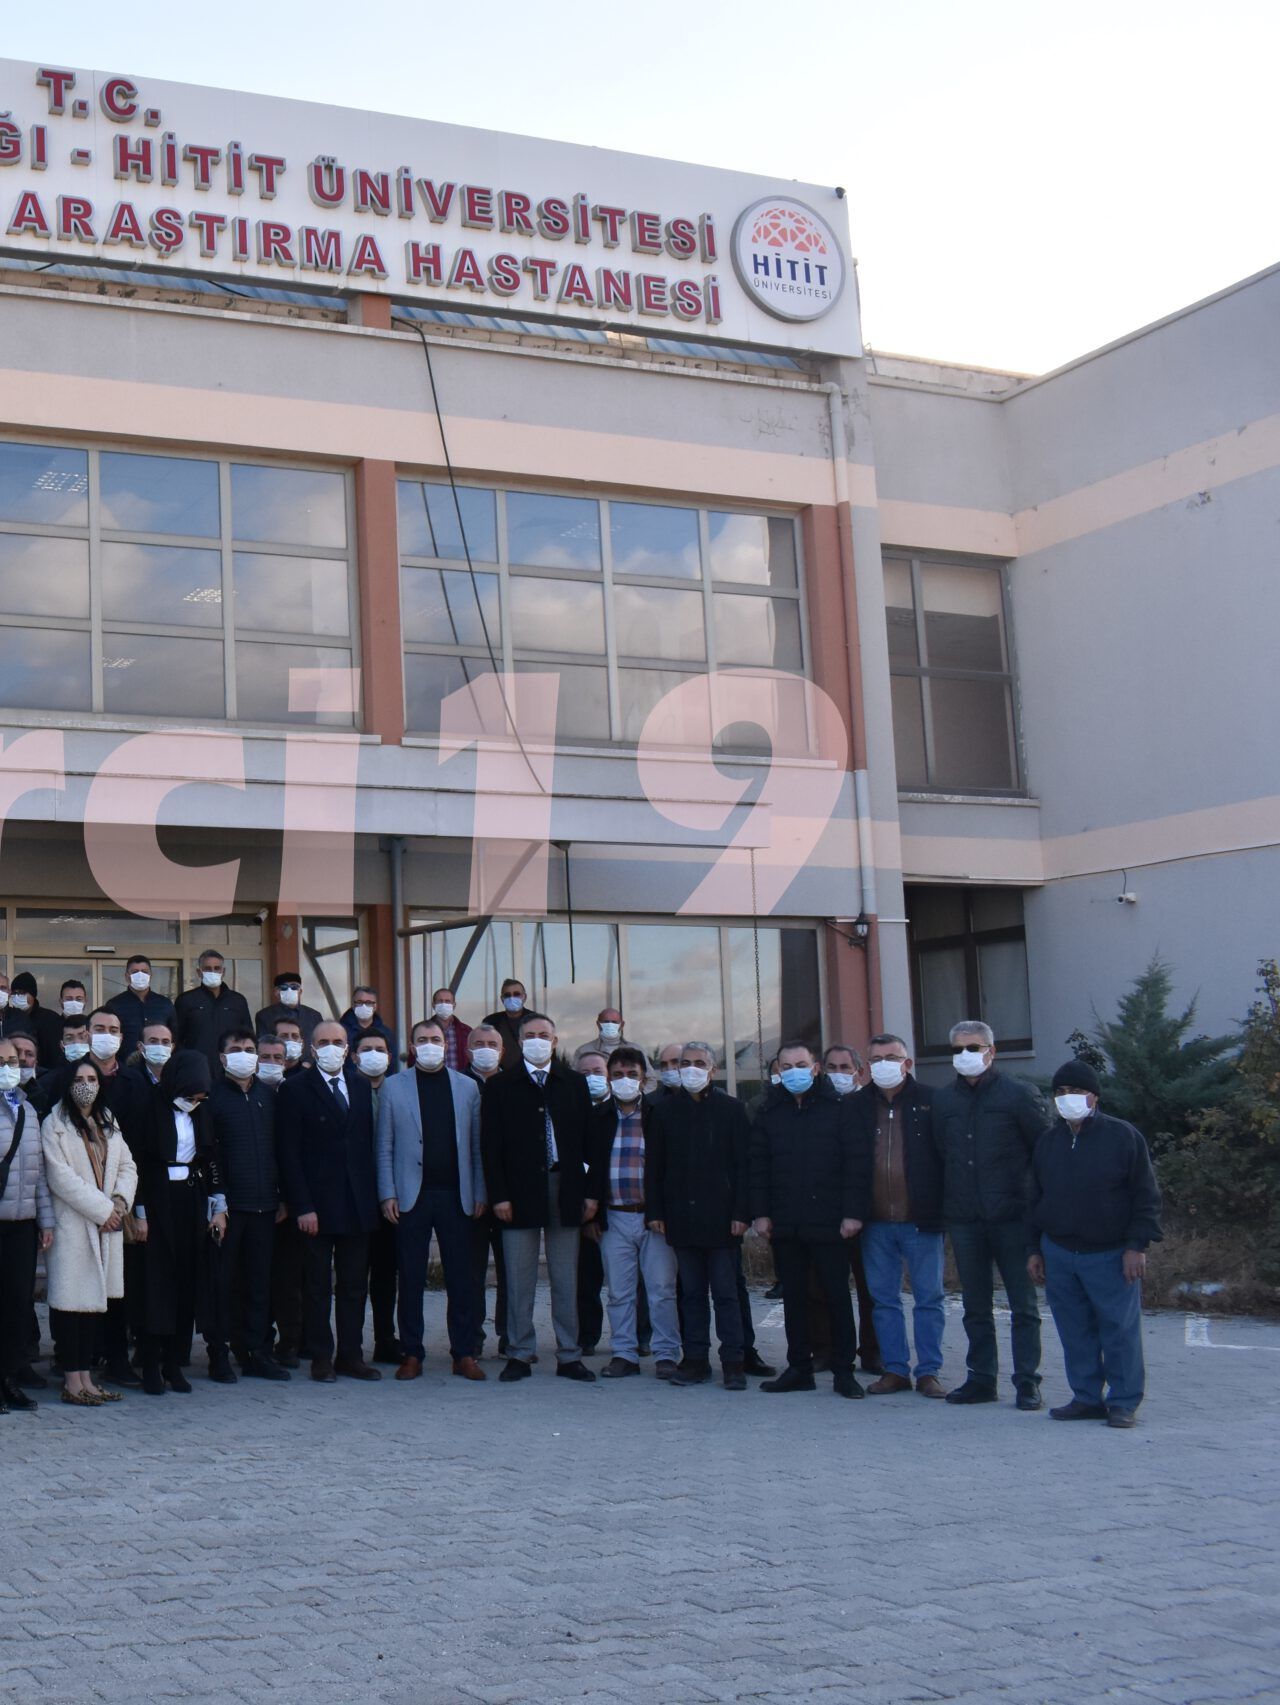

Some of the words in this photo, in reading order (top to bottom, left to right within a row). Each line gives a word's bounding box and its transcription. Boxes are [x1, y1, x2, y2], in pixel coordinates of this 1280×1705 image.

[36, 67, 161, 127] T.C.
[70, 148, 92, 165] -
[114, 132, 287, 200] HİTİT
[306, 155, 718, 263] ÜNİVERSİTESİ
[6, 190, 389, 280] ARAŞTIRMA
[405, 239, 722, 325] HASTANESİ
[752, 252, 828, 286] HİTİT
[753, 277, 832, 300] ÜNİVERSİTESİ
